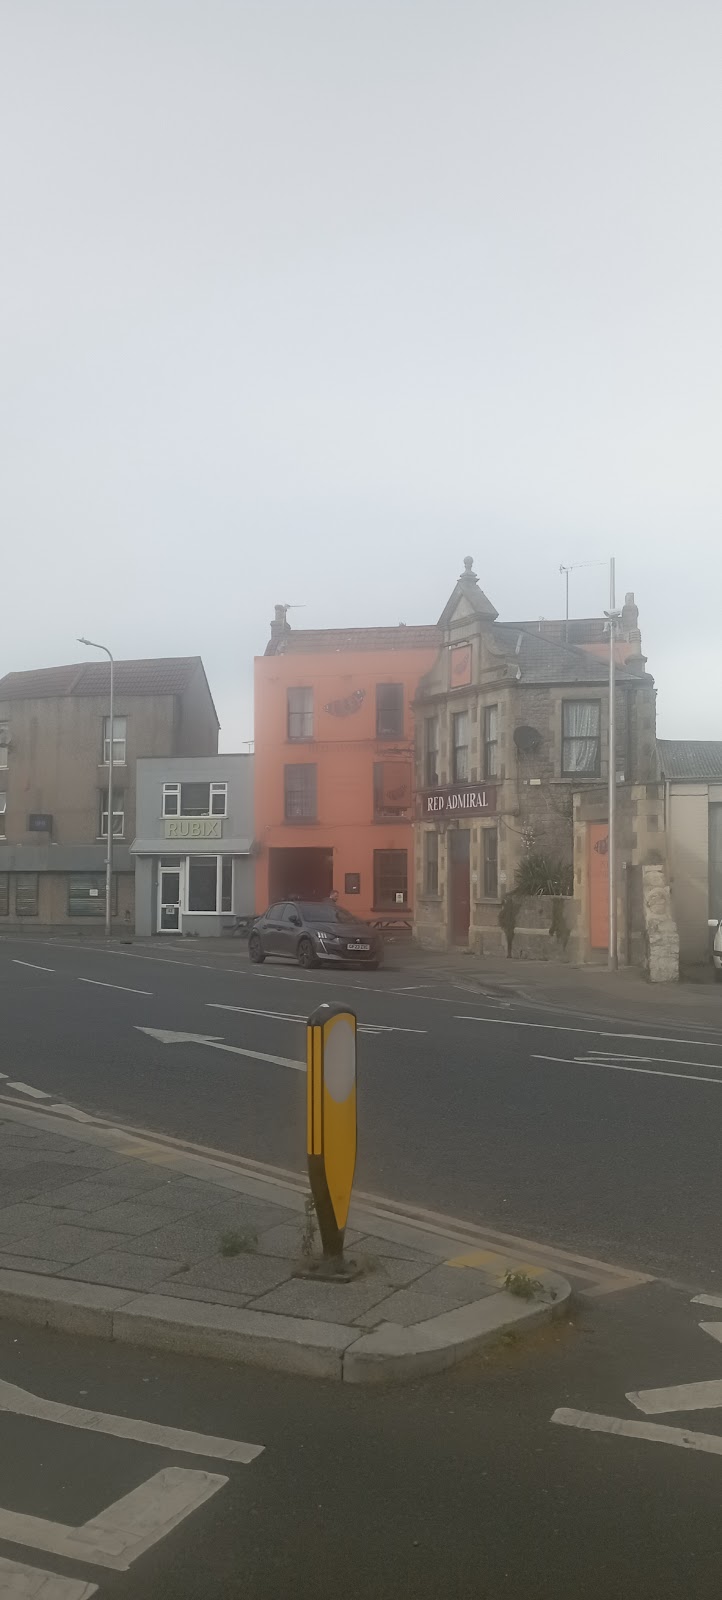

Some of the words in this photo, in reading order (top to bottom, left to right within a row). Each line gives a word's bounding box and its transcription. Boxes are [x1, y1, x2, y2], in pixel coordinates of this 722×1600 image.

[427, 796, 444, 811] RED
[446, 792, 488, 810] ADMIRAL
[167, 822, 218, 836] RUBIX
